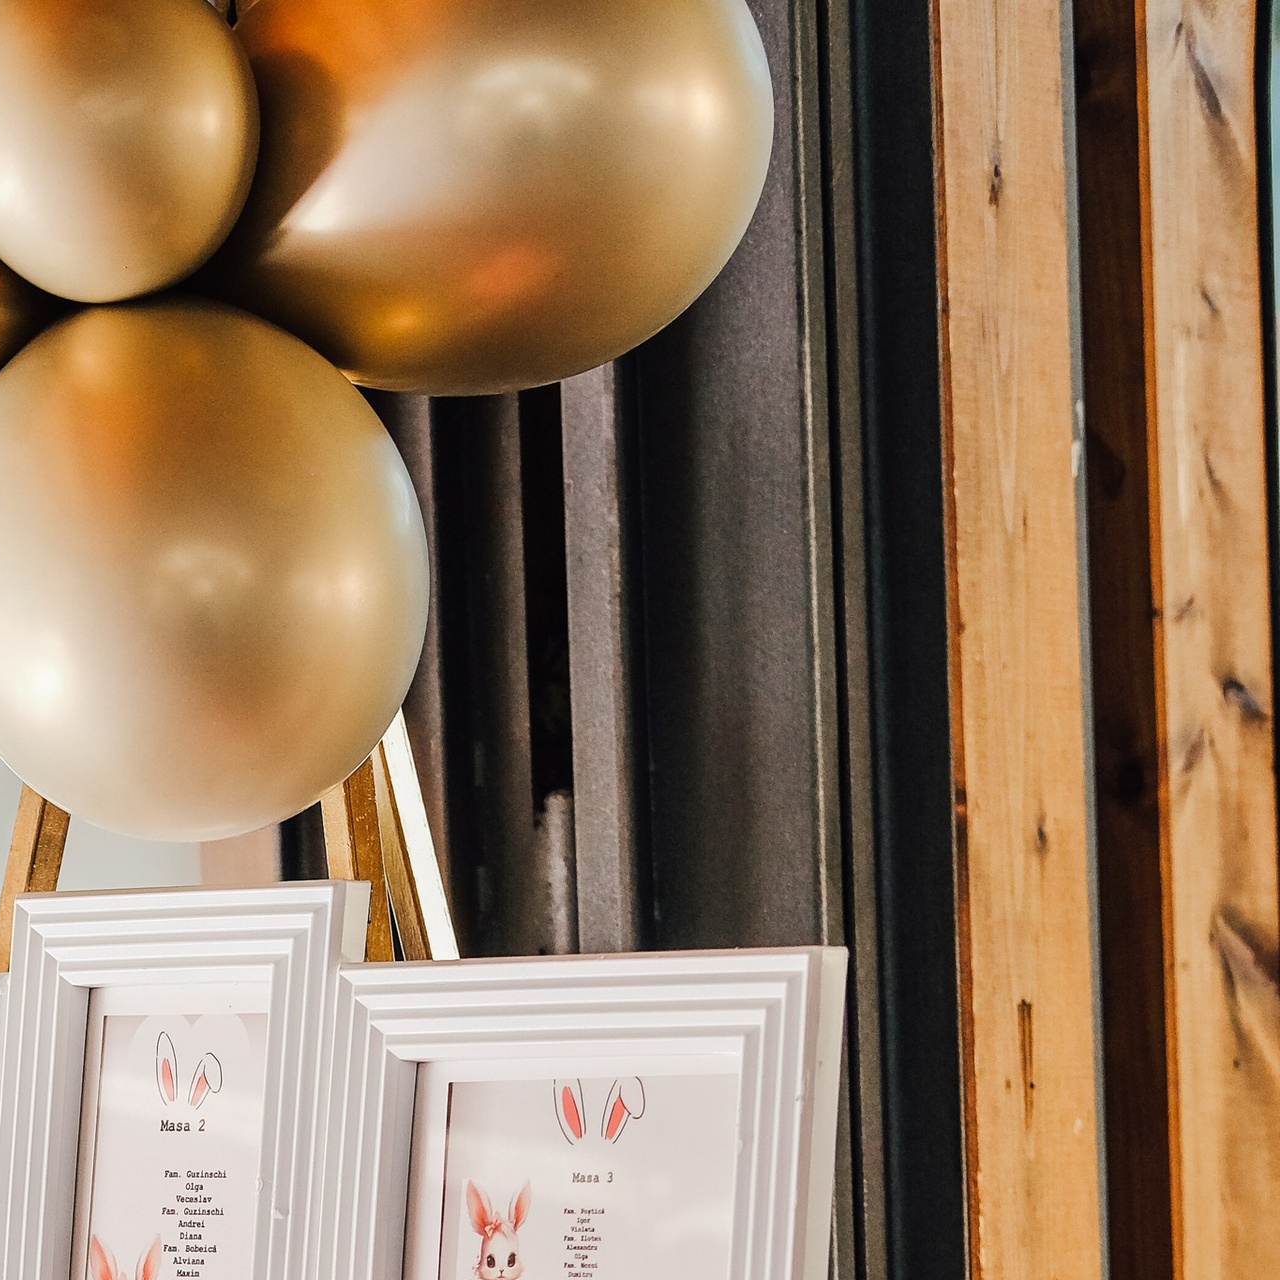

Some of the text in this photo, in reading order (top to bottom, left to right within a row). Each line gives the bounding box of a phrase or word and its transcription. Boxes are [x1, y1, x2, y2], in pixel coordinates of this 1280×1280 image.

[159, 1118, 206, 1132] Masa 2
[164, 1169, 182, 1179] Fam.
[571, 1171, 614, 1184] Masa 3
[185, 1182, 204, 1193] Olga
[161, 1206, 179, 1216] Fam.
[177, 1219, 206, 1229] Andrei
[179, 1231, 203, 1241] Diana
[163, 1244, 181, 1253] Fam.
[172, 1256, 205, 1266] Alviana
